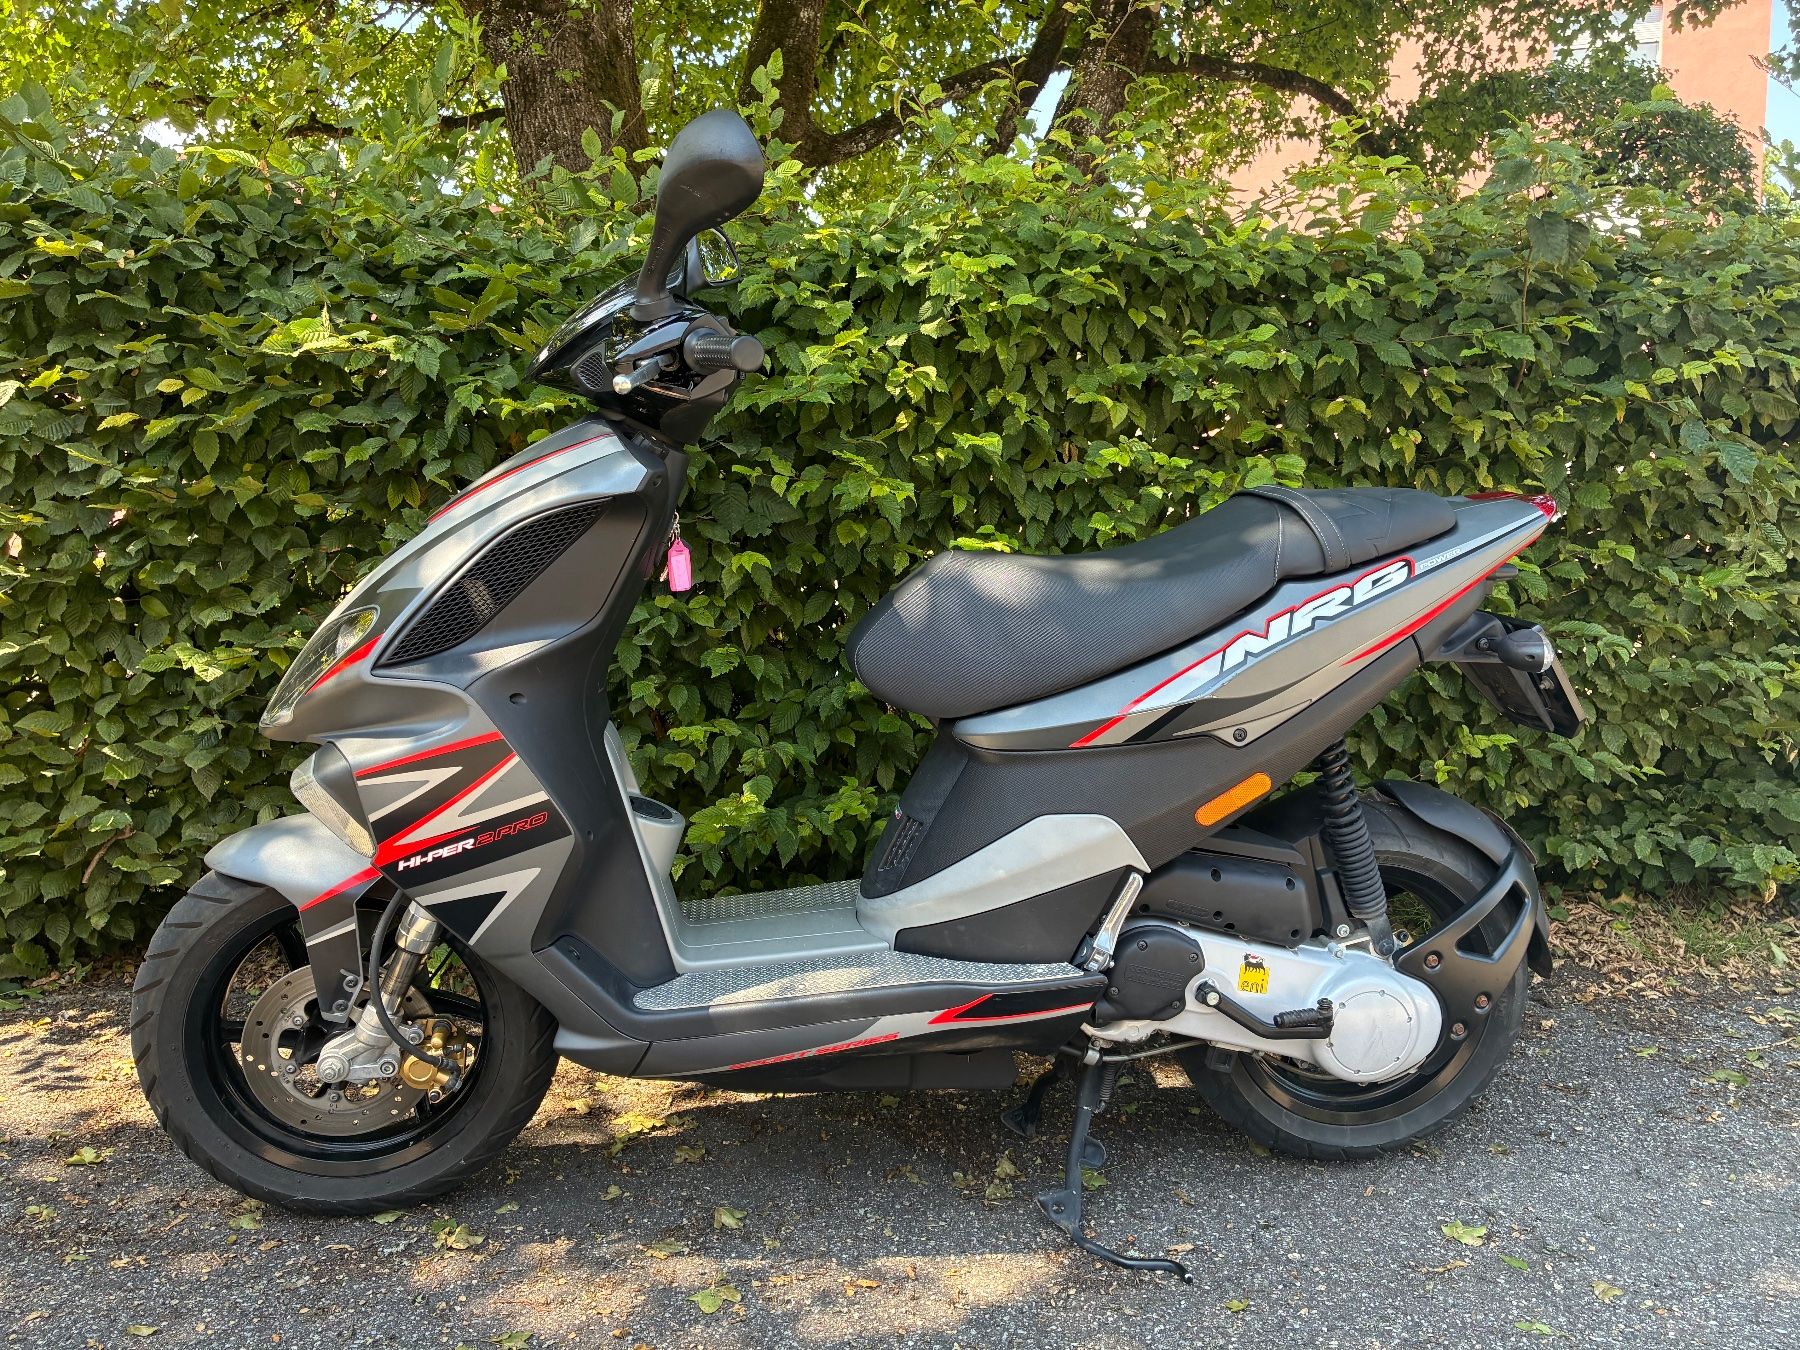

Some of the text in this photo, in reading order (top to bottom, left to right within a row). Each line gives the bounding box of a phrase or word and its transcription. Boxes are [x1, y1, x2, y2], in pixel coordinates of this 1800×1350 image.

[1222, 560, 1410, 672] NRG
[397, 838, 475, 871] HI-PER
[495, 811, 548, 840] PRO
[1240, 978, 1265, 994] eni
